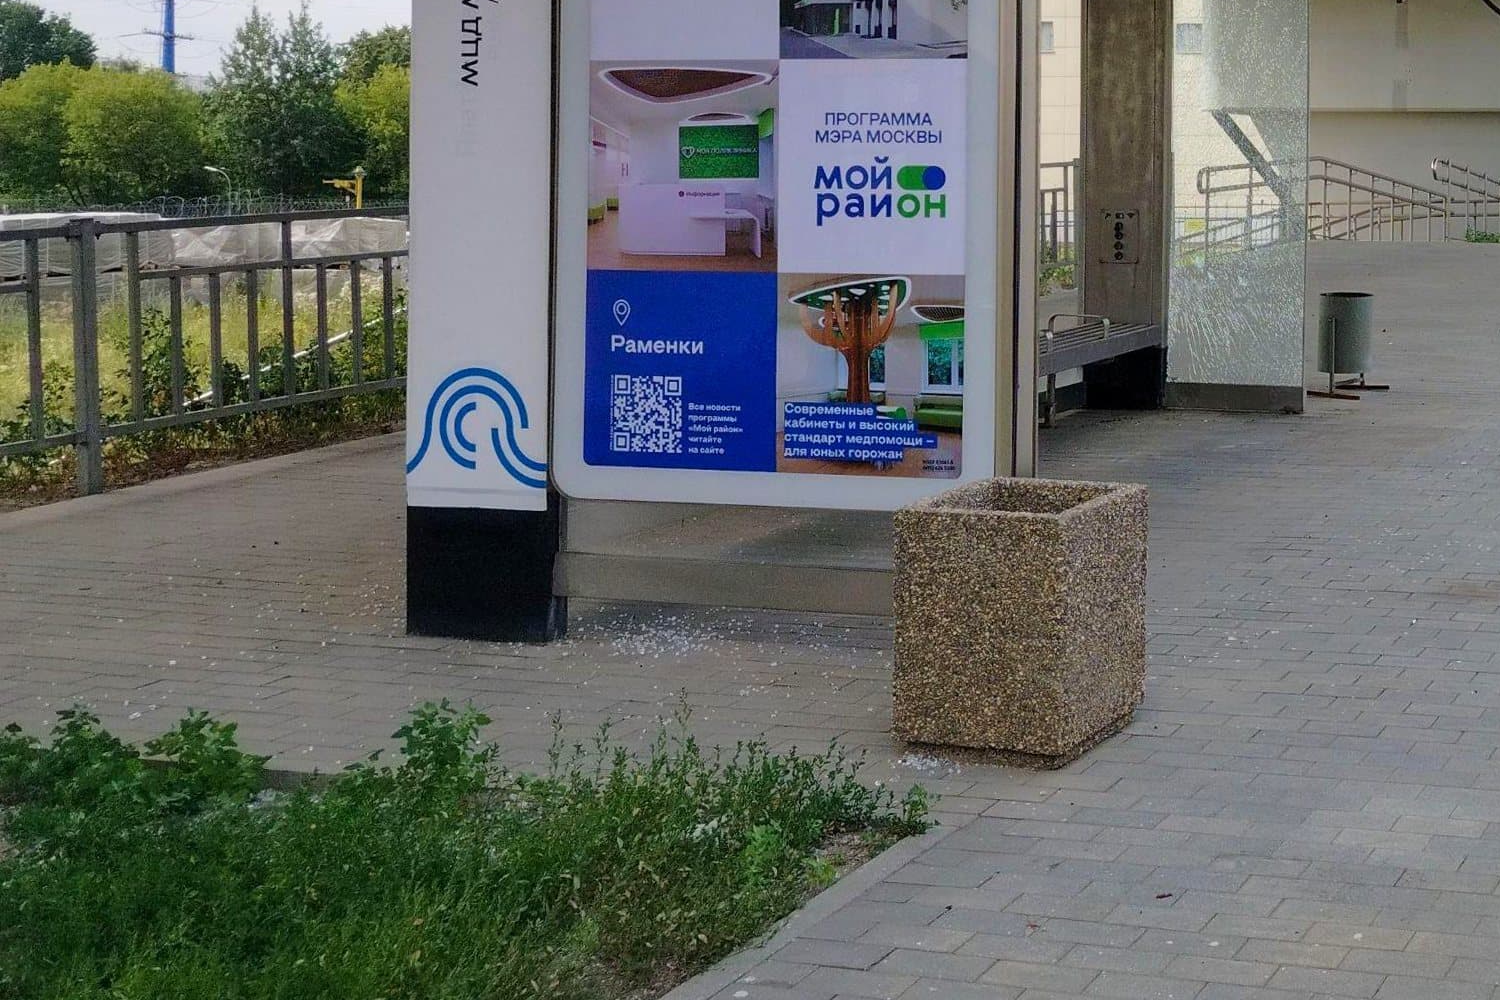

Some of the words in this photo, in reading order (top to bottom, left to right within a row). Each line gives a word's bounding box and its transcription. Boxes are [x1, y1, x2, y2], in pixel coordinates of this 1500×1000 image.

[461, 16, 482, 86] МЦД
[825, 112, 933, 126] ПРОГРАММА
[815, 130, 862, 143] МЭРА
[866, 130, 942, 143] МОСКВЫ
[814, 156, 892, 190] мой
[611, 335, 704, 354] Раменки
[784, 403, 874, 416] Современные
[688, 415, 737, 423] программы
[784, 418, 846, 430] кабинеты
[848, 421, 857, 429] и
[859, 420, 915, 431] высокий
[784, 433, 843, 445] стандарт
[845, 436, 923, 446] медпомощи
[784, 447, 808, 457] для
[810, 448, 846, 457] юных
[848, 449, 903, 460] горожан
